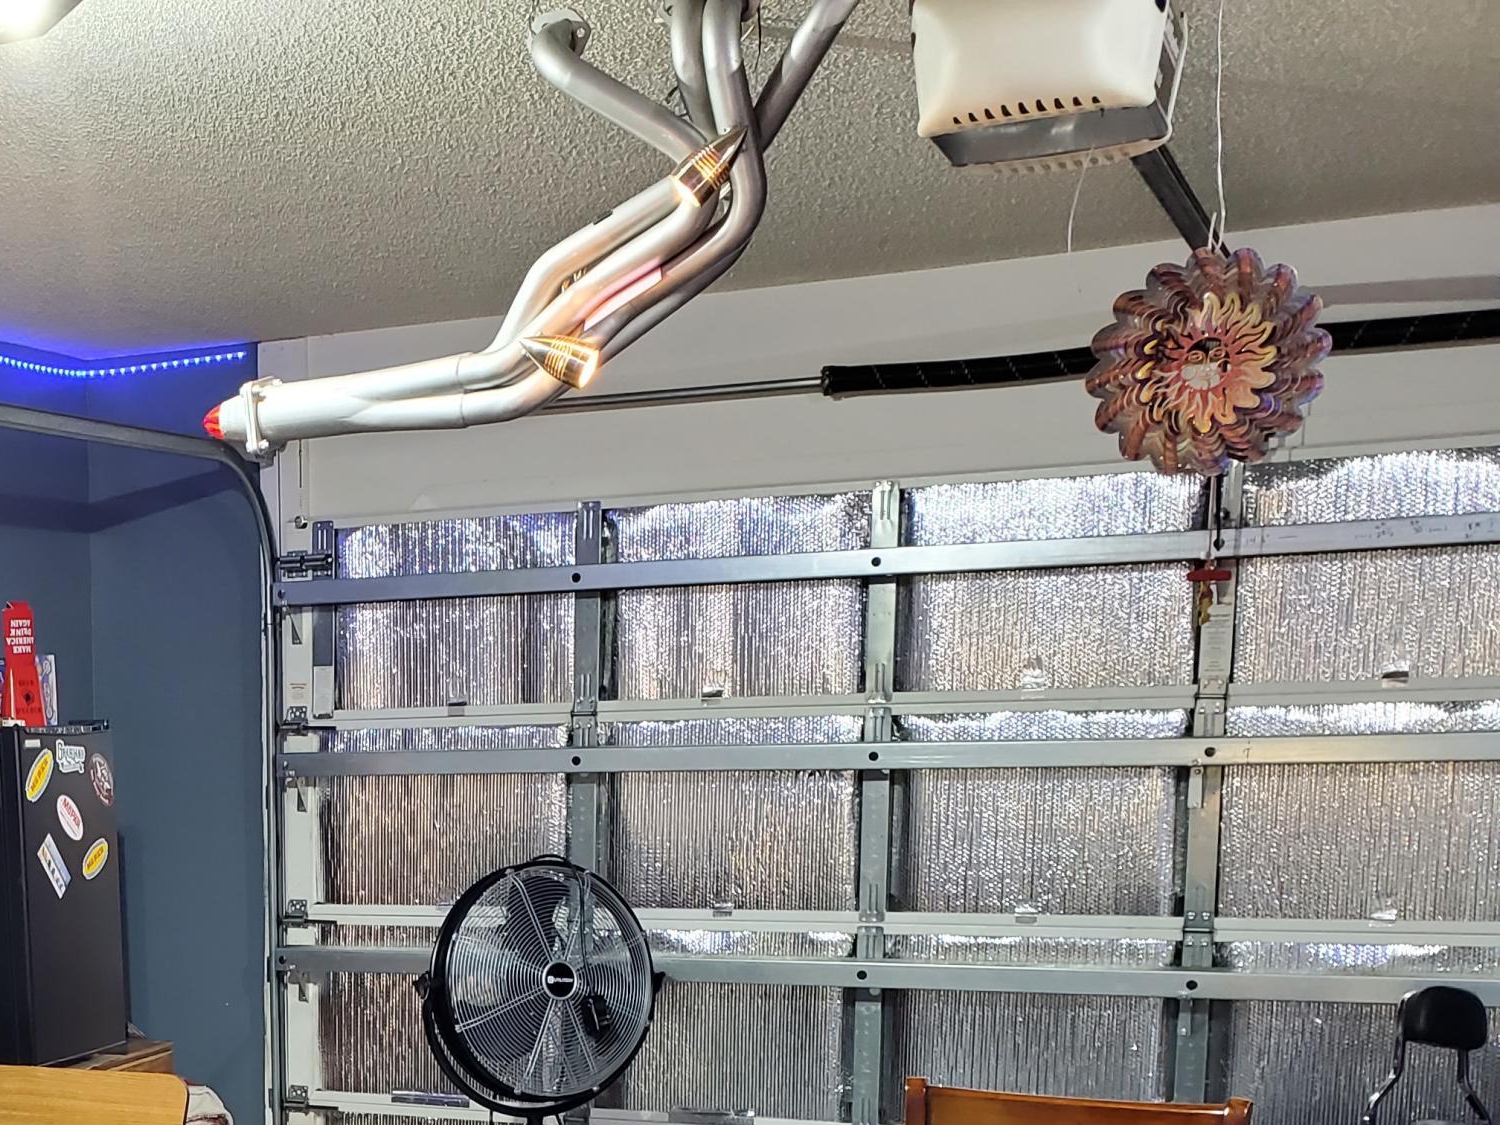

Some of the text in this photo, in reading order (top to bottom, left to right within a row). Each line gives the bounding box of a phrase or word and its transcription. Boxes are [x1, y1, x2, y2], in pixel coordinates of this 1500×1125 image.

[10, 619, 31, 628] AGAIN
[9, 627, 32, 637] DRINK
[5, 636, 35, 646] AMERICA
